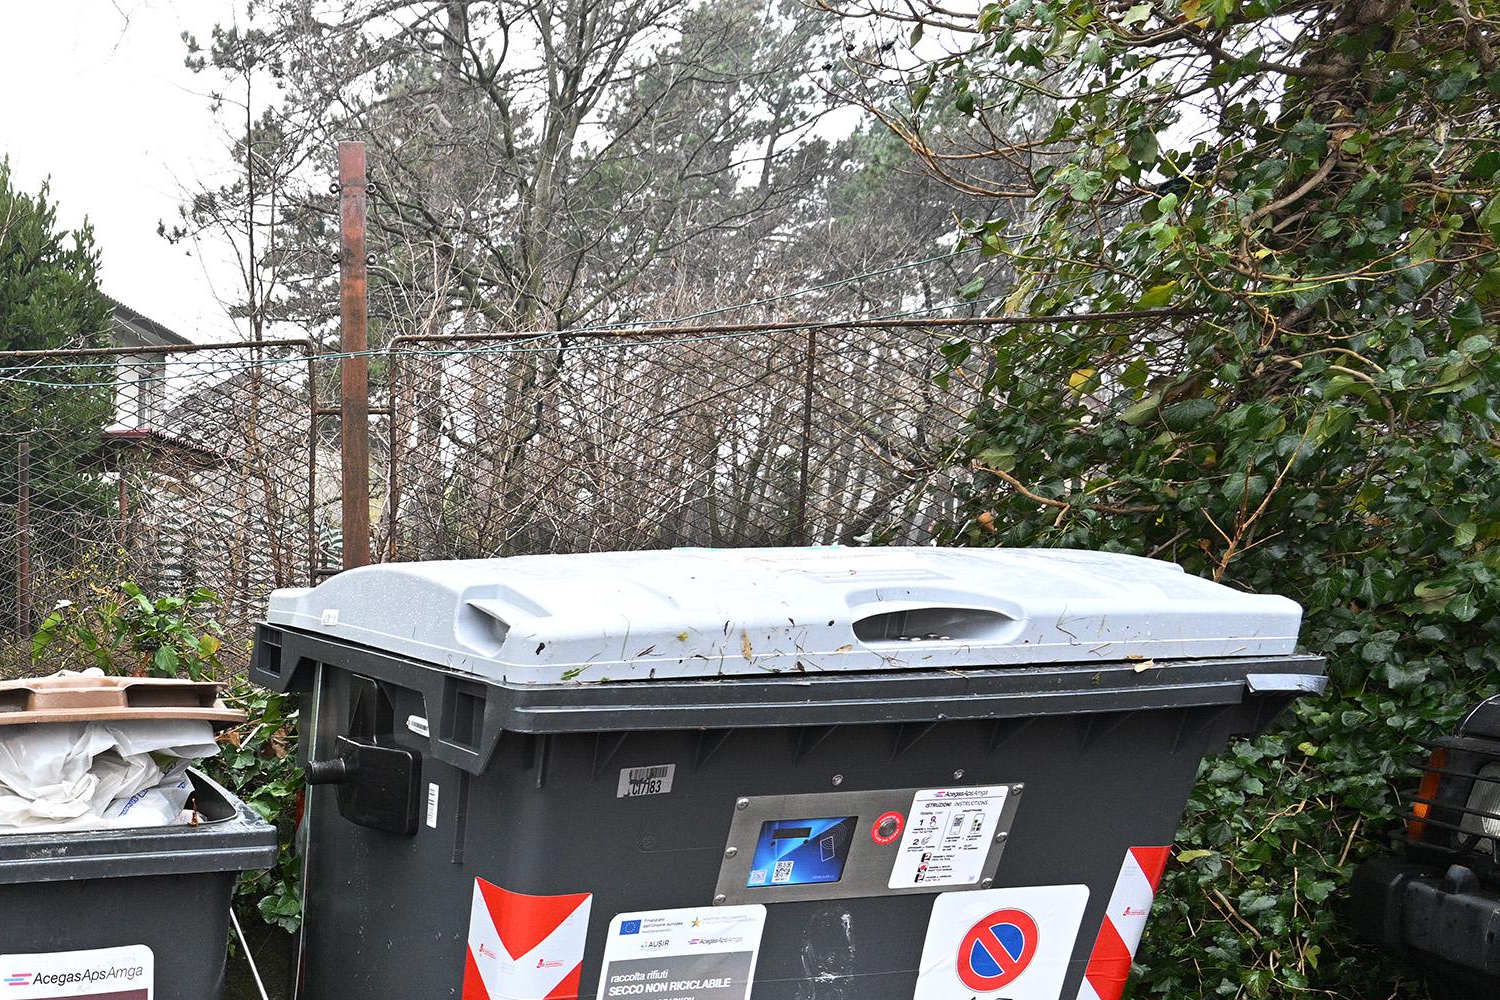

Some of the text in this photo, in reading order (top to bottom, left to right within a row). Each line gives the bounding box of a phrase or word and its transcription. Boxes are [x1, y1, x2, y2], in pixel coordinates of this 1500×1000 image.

[33, 966, 143, 986] AcegasApsAmga
[611, 969, 668, 983] raccolta rifiuti
[609, 978, 731, 996] SECCO NON RICICLABILE
